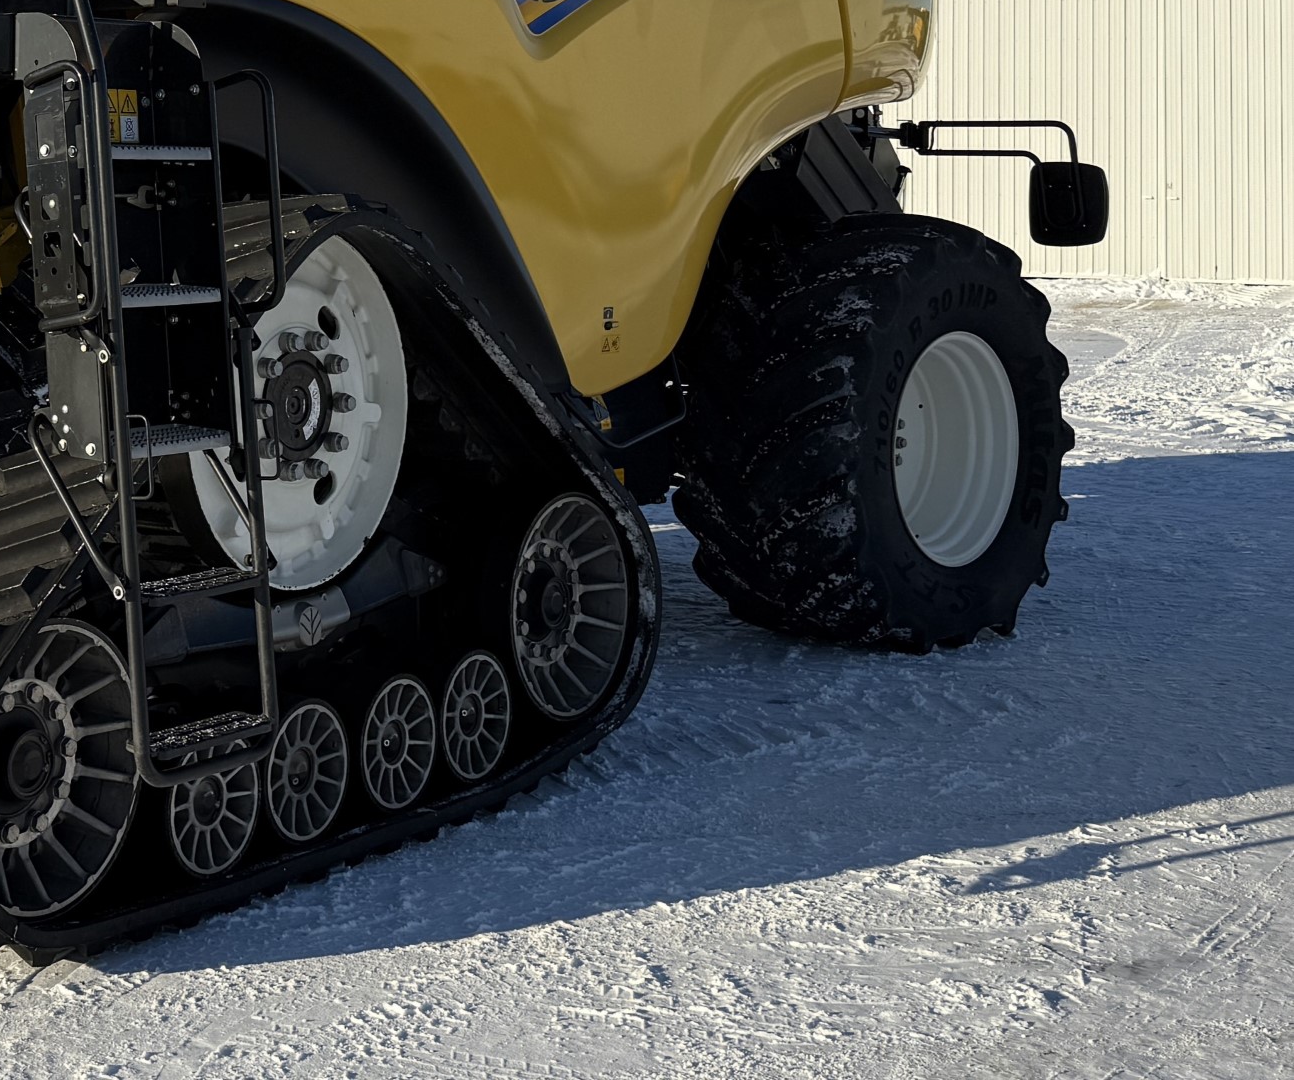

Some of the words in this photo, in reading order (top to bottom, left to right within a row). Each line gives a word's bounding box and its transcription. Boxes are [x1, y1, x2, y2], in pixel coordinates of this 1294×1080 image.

[873, 349, 904, 475] 710/60
[908, 315, 923, 342] R
[927, 287, 953, 321] 30
[958, 282, 998, 310] IMP
